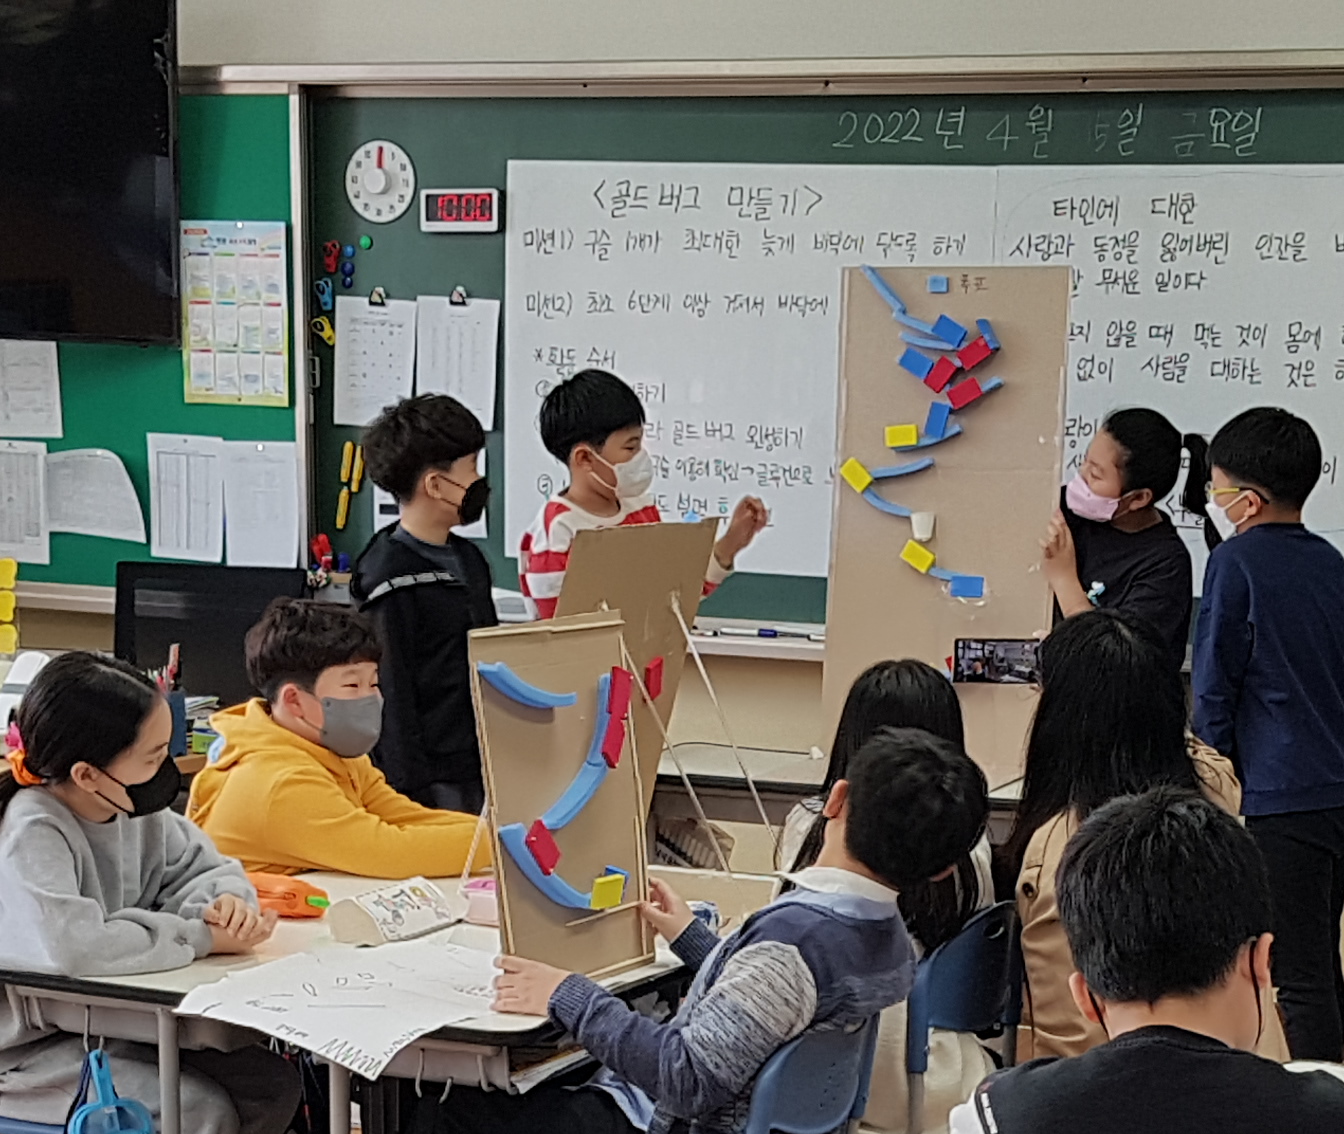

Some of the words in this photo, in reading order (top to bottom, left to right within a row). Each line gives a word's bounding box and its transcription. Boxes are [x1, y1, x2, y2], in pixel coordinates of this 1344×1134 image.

[1170, 106, 1263, 158] 금요일
[1053, 196, 1120, 226] 타인에
[1150, 193, 1197, 225] 대한
[583, 229, 613, 261] 구슬
[932, 233, 966, 256] 하기
[1009, 233, 1076, 262] 사랑과
[1092, 230, 1140, 265] 동정을
[1159, 231, 1230, 265] 잃어버린
[1255, 231, 1308, 263] 인간을
[1095, 268, 1141, 295] 무서운
[1155, 268, 1208, 293] 일이다
[1148, 322, 1174, 345] 때
[1194, 322, 1222, 350] 먹는
[1236, 322, 1268, 348] 것이
[1284, 321, 1321, 354] 몸에
[1140, 352, 1190, 385] 사람을
[1210, 357, 1263, 386] 대하는
[1284, 359, 1318, 389] 것은
[633, 382, 666, 404] 하기
